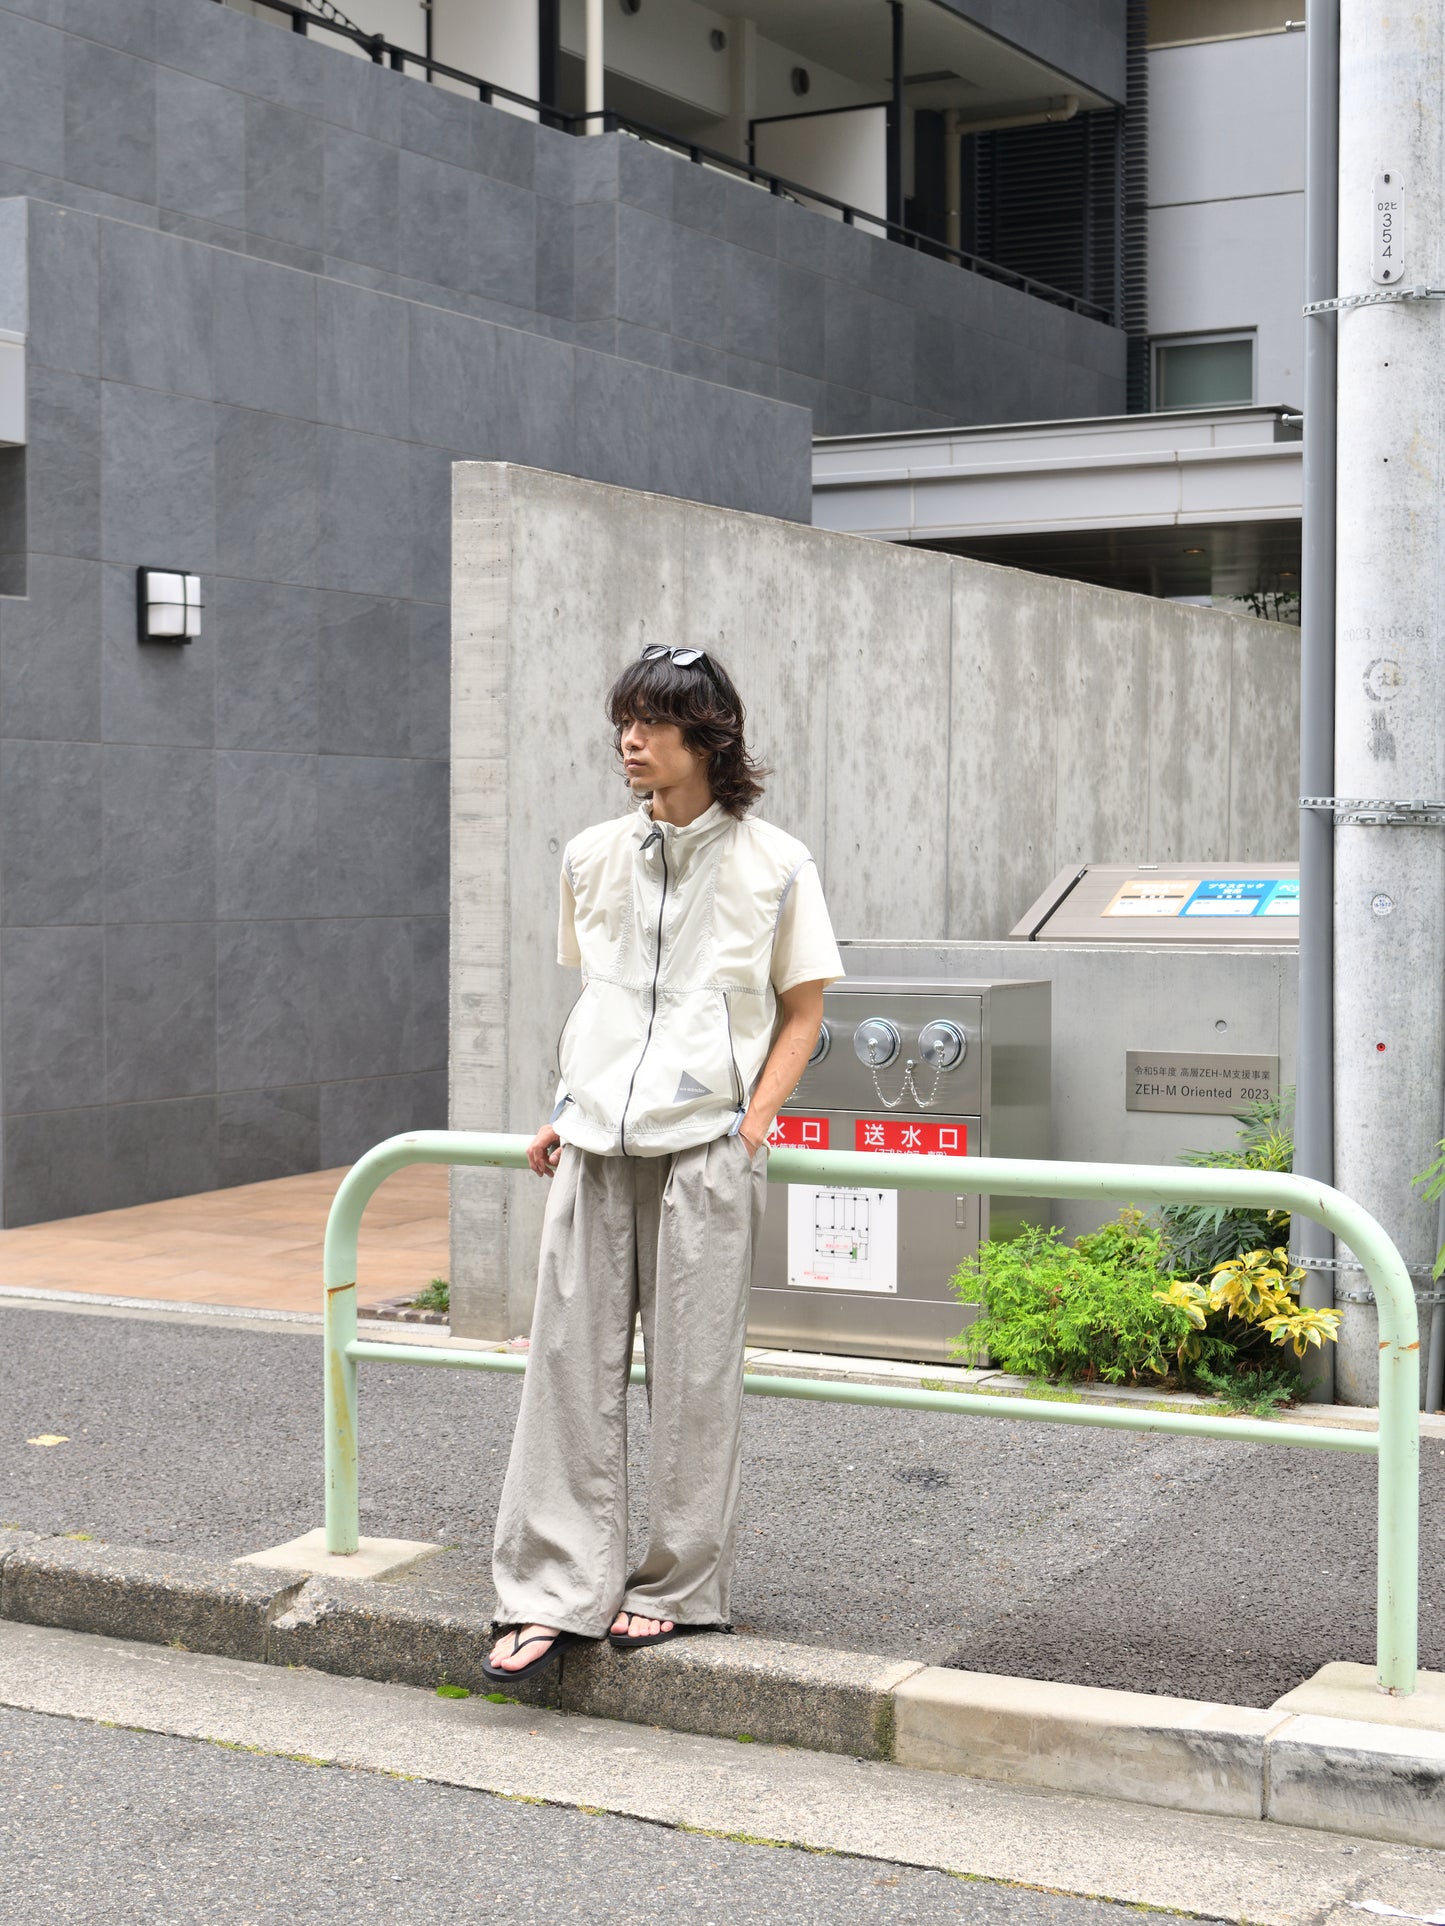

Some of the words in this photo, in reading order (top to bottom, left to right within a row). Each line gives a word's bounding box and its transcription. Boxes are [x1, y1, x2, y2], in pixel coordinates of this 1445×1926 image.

[1382, 213, 1392, 258] 354
[1134, 1065, 1177, 1078] 令和5年度
[1180, 1067, 1271, 1081] 高層ZEH-M支援事業
[1135, 1083, 1177, 1096] ZEH-M
[1181, 1085, 1232, 1099] Oriented
[1240, 1088, 1270, 1100] 2023
[864, 1123, 958, 1150] 送水口
